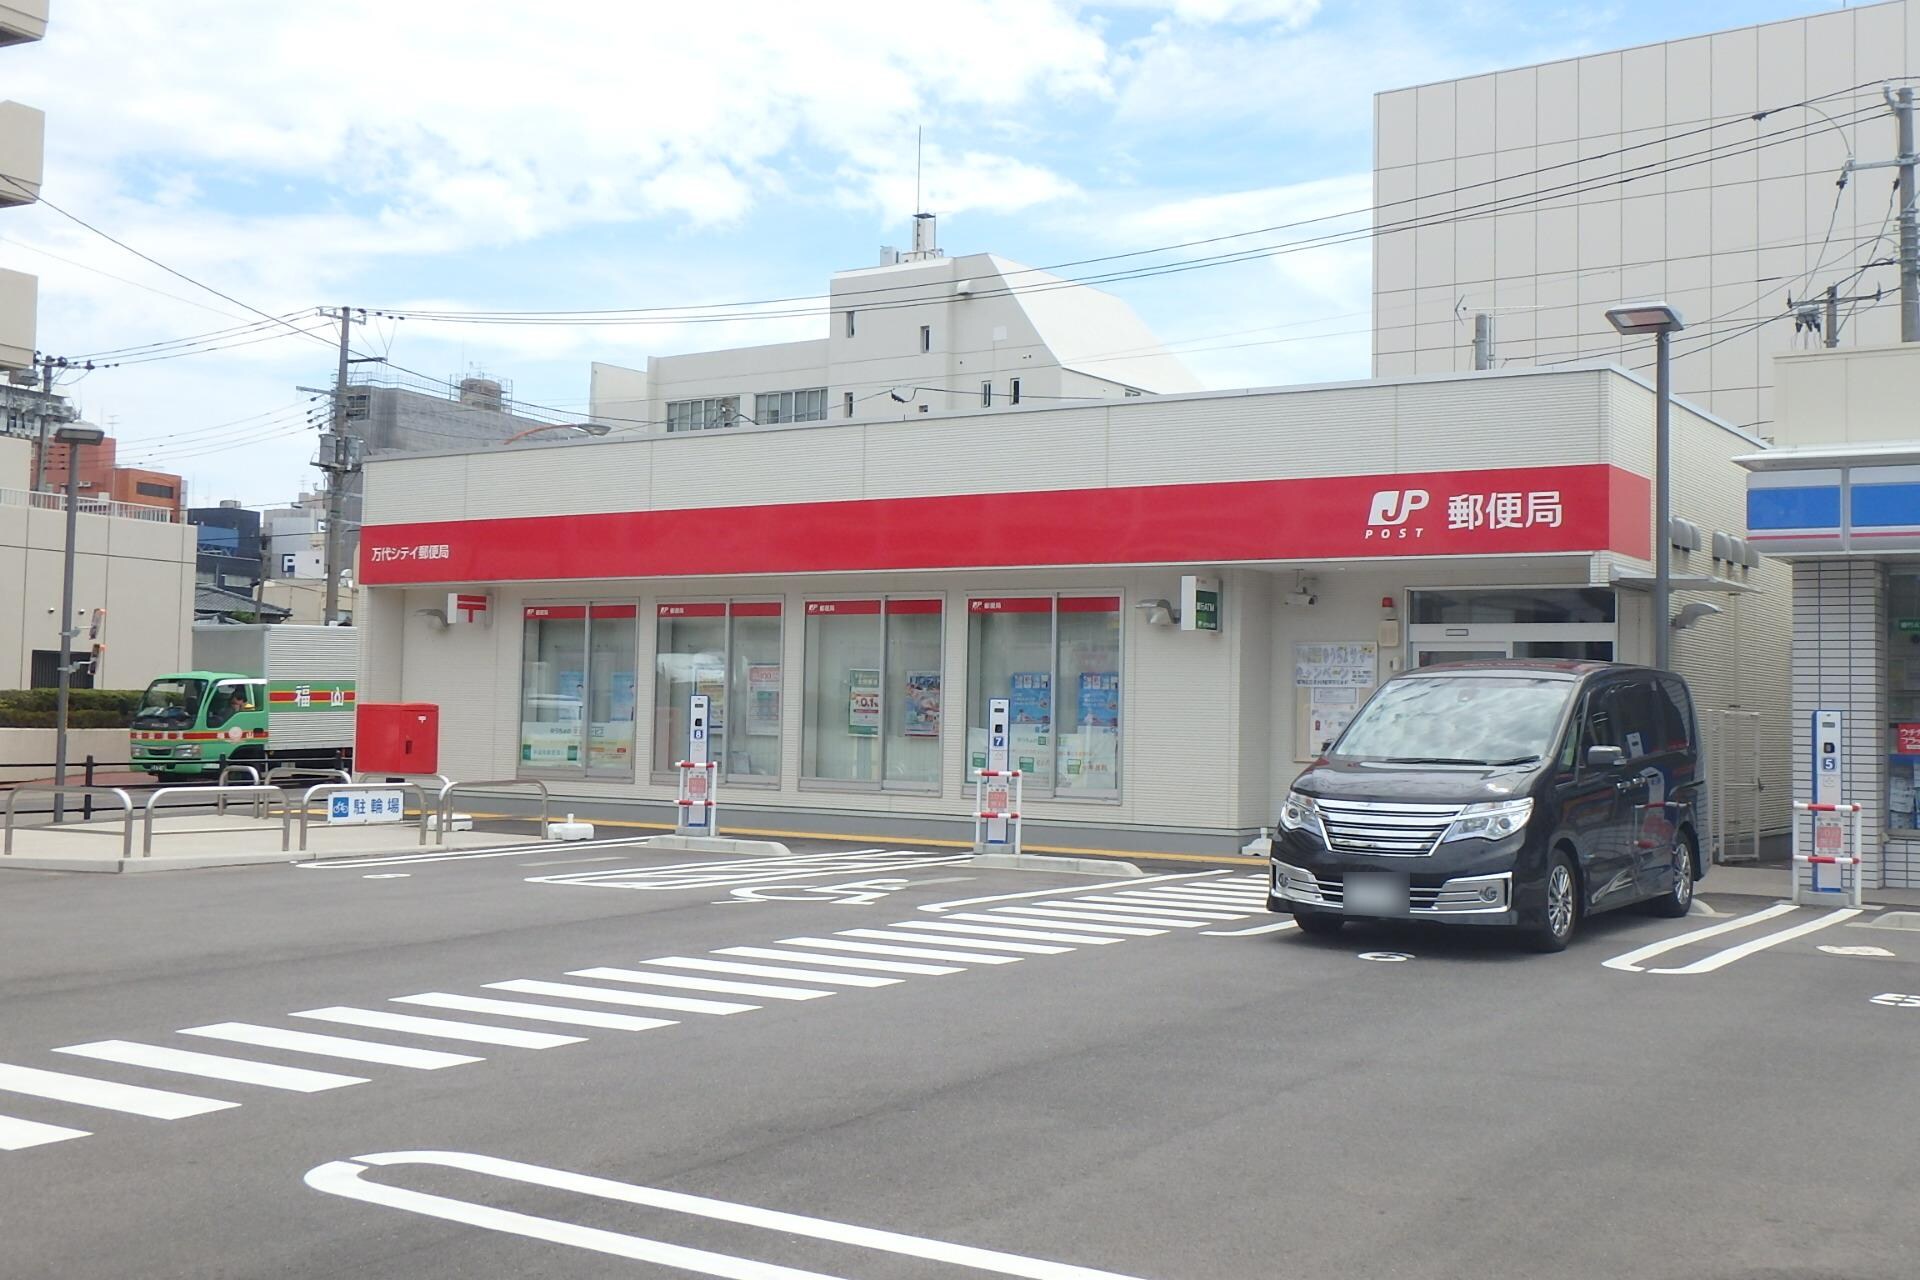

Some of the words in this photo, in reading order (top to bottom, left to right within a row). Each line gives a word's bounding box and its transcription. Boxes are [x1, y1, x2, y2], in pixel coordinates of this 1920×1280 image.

[1368, 490, 1429, 526] JP
[1448, 491, 1562, 530] 郵便局
[1365, 528, 1423, 539] POST
[371, 545, 449, 562] 万代シテイ郵便局
[295, 685, 344, 707] 福山
[1825, 759, 1833, 769] 5
[354, 798, 399, 815] 駐輪場
